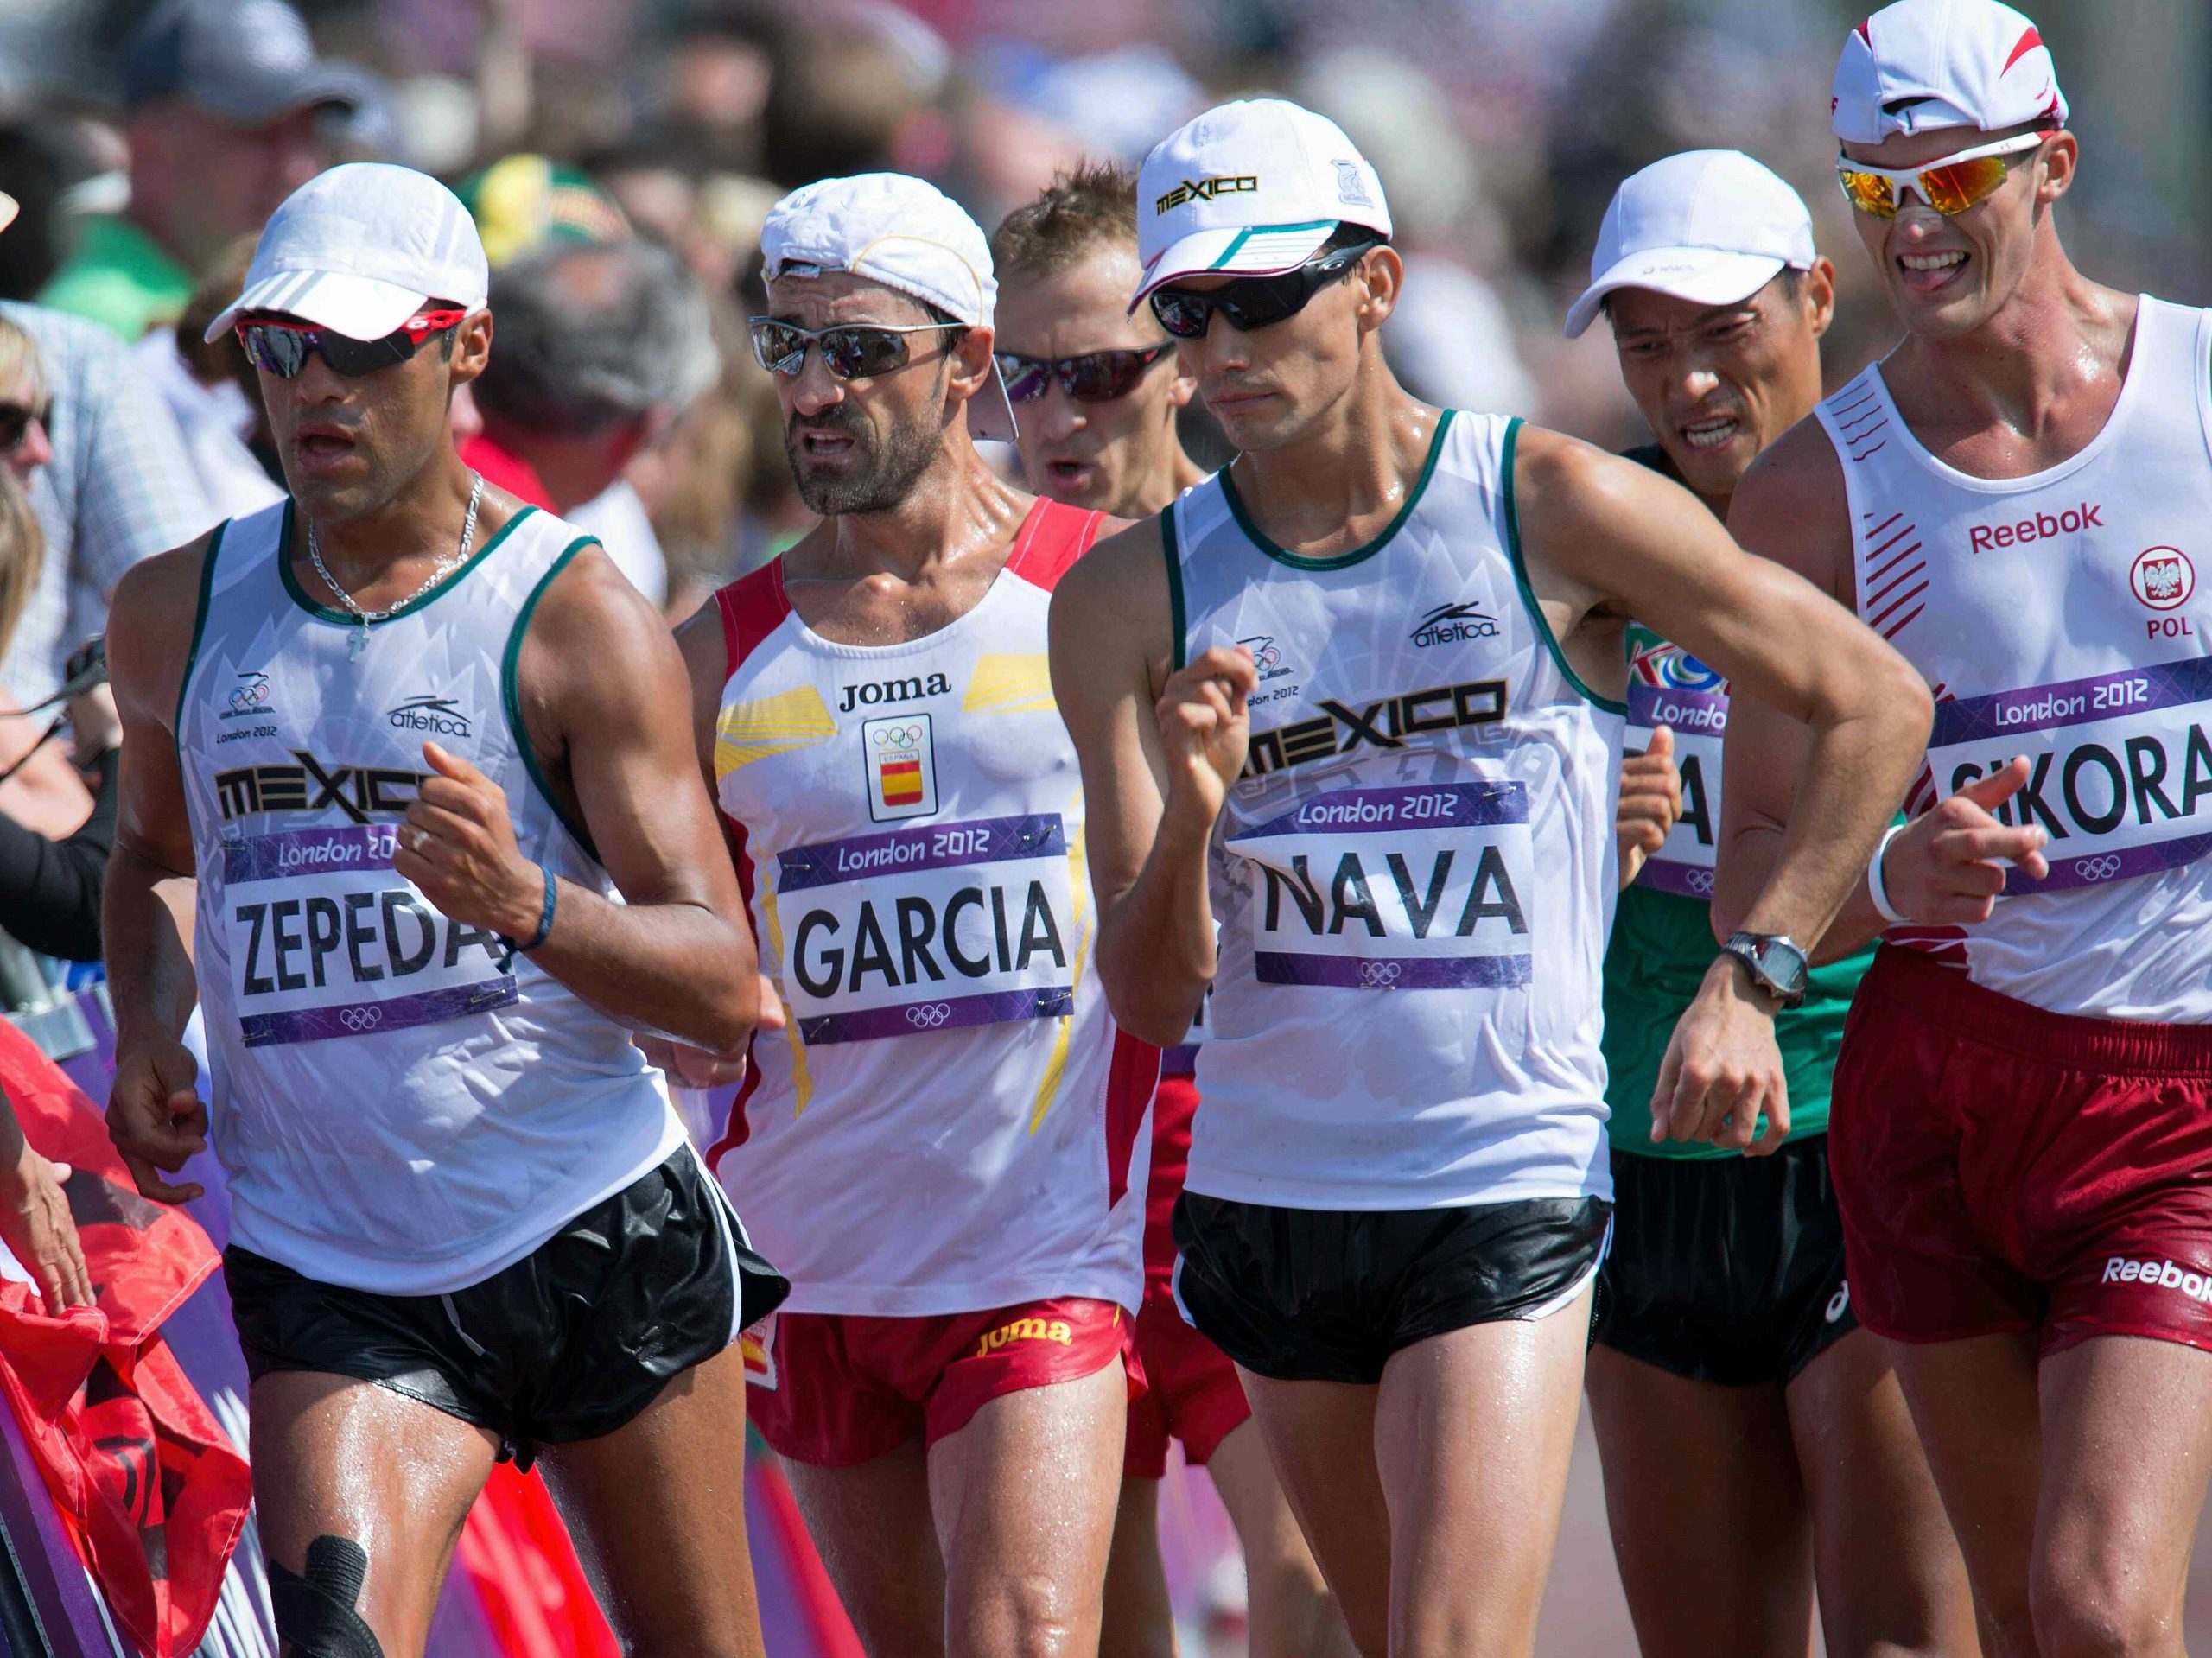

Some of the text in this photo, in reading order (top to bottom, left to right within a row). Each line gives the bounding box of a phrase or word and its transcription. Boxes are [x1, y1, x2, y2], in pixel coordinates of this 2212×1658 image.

[1156, 175, 1258, 217] MEXICO
[1969, 501, 2104, 555] Reebok
[2147, 616, 2194, 640] POL
[839, 671, 952, 713] Joma
[1247, 685, 1300, 708] don 2012
[1651, 696, 1727, 730] Londo
[1995, 678, 2149, 727] London 2012
[216, 726, 277, 745] London 2012
[213, 749, 441, 825] MEXIC
[1298, 792, 1459, 825] London 2012
[278, 835, 396, 867] London 20
[837, 829, 992, 873] London 2012
[1250, 844, 1529, 940] NAVA
[792, 879, 1067, 999] GARCIA
